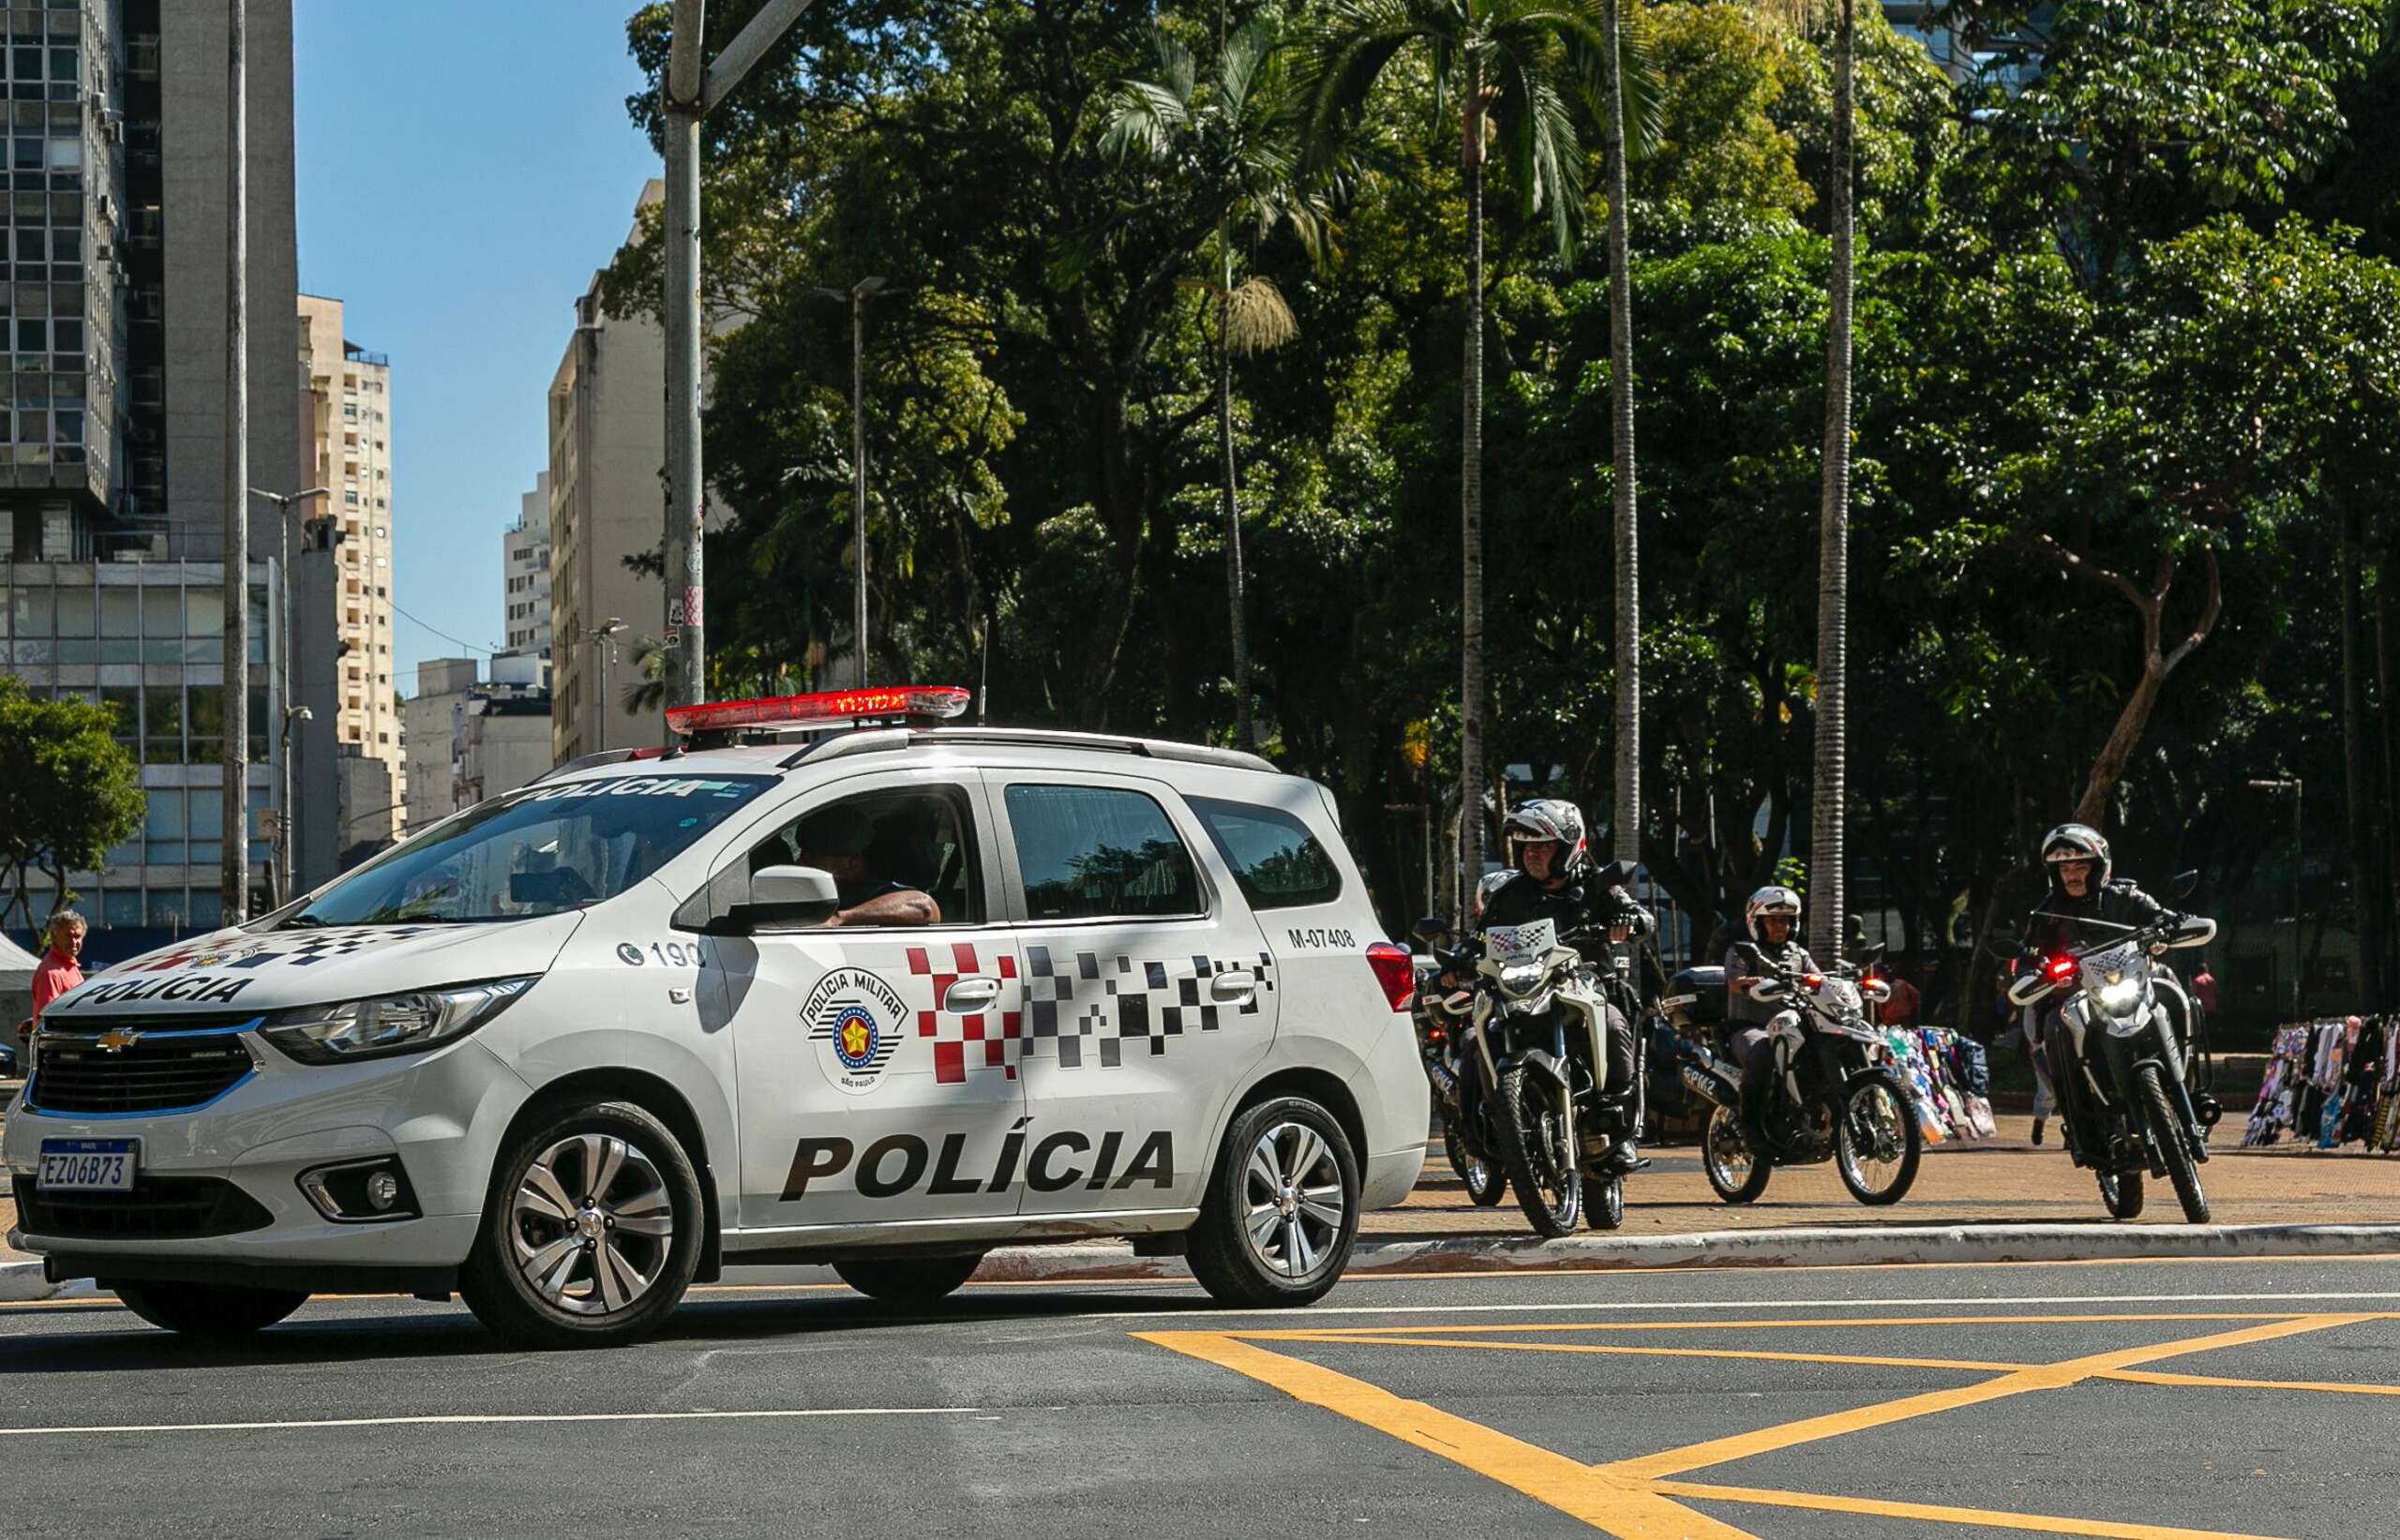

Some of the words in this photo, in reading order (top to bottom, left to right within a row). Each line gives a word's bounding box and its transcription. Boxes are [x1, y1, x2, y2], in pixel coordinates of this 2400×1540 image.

[651, 942, 706, 968] 190
[1288, 929, 1356, 949] M-07408
[65, 972, 255, 1009] POLÍCIA
[854, 973, 902, 1020] MILITAR
[779, 1116, 1174, 1202] POLÍCIA
